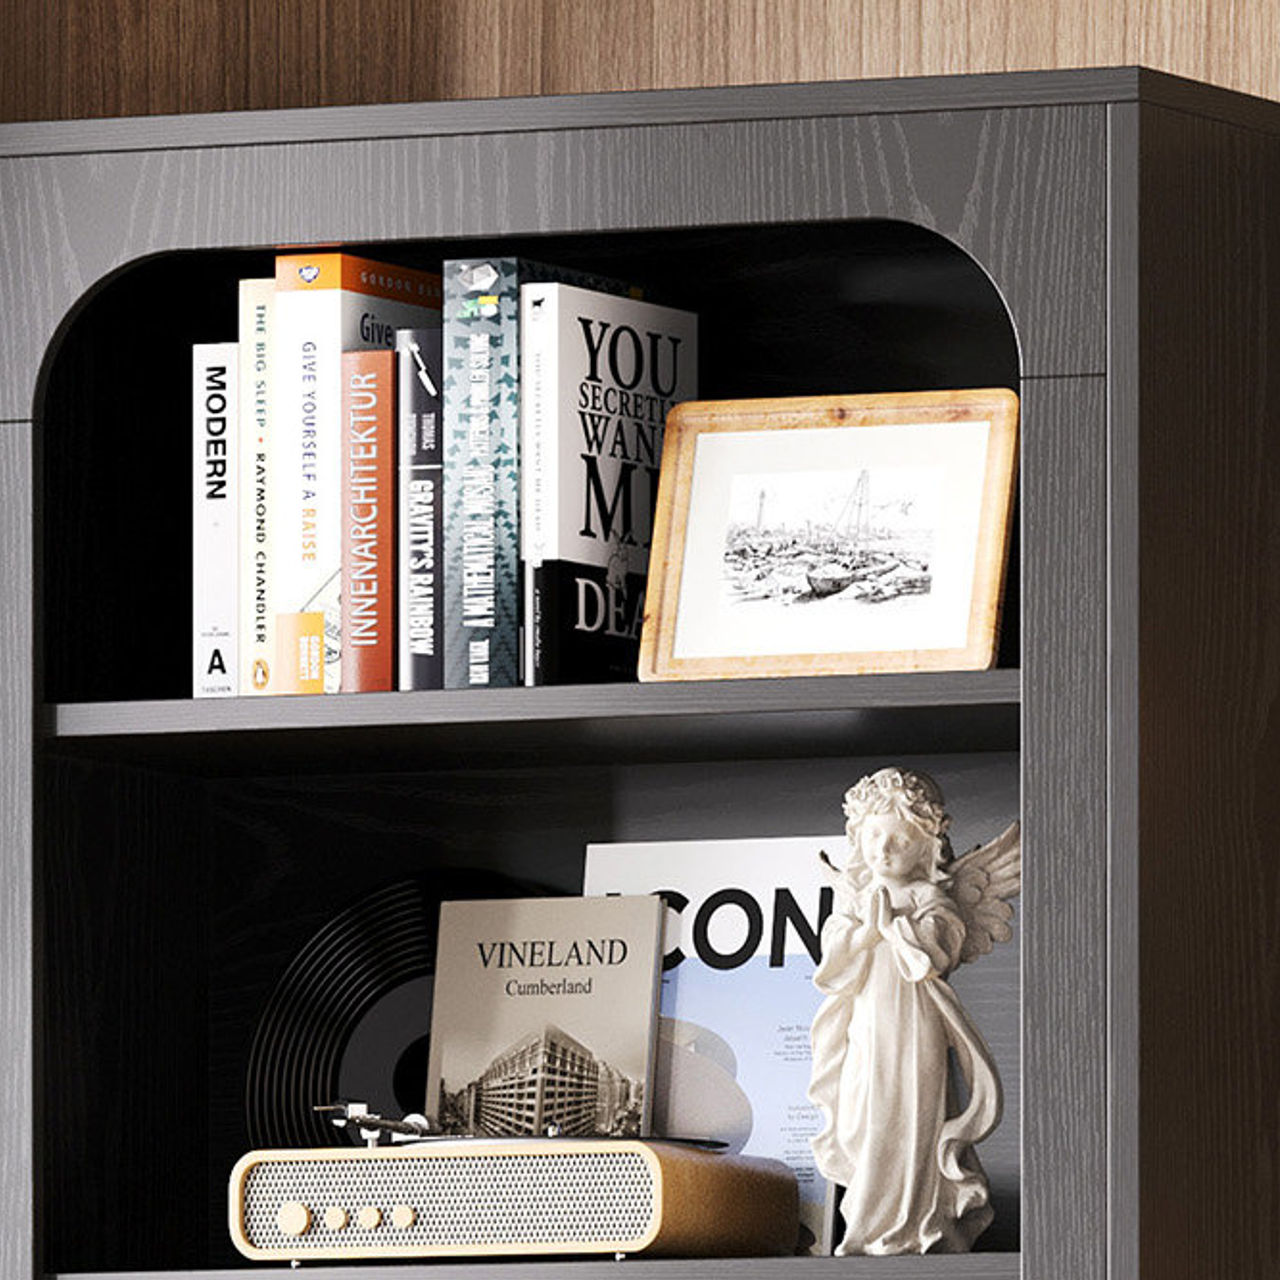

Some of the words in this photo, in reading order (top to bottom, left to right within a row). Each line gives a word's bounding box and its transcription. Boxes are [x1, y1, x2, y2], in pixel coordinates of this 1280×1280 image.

[255, 305, 266, 332] THE
[361, 313, 394, 347] Give
[255, 342, 266, 372] BIG
[302, 341, 317, 382] GIVE
[578, 317, 681, 397] YOU
[255, 380, 266, 427] SLEEP
[579, 382, 678, 423] SECRETL
[205, 366, 227, 499] MODERN
[302, 391, 317, 482] YOURSELF
[578, 411, 664, 464] WAN
[255, 453, 267, 543] RAYMOND
[302, 489, 317, 500] A
[350, 372, 378, 647] INNENARCHITEKTUR
[302, 508, 317, 561] RAISE
[409, 480, 434, 570] GRAVITY'S
[463, 517, 495, 617] MATHEMATICAL
[255, 551, 267, 643] CHANDLER
[409, 573, 434, 656] RAINBOW
[463, 618, 495, 627] A
[207, 649, 227, 675] A
[477, 939, 628, 968] VINELAND
[505, 977, 593, 996] Cumberland
